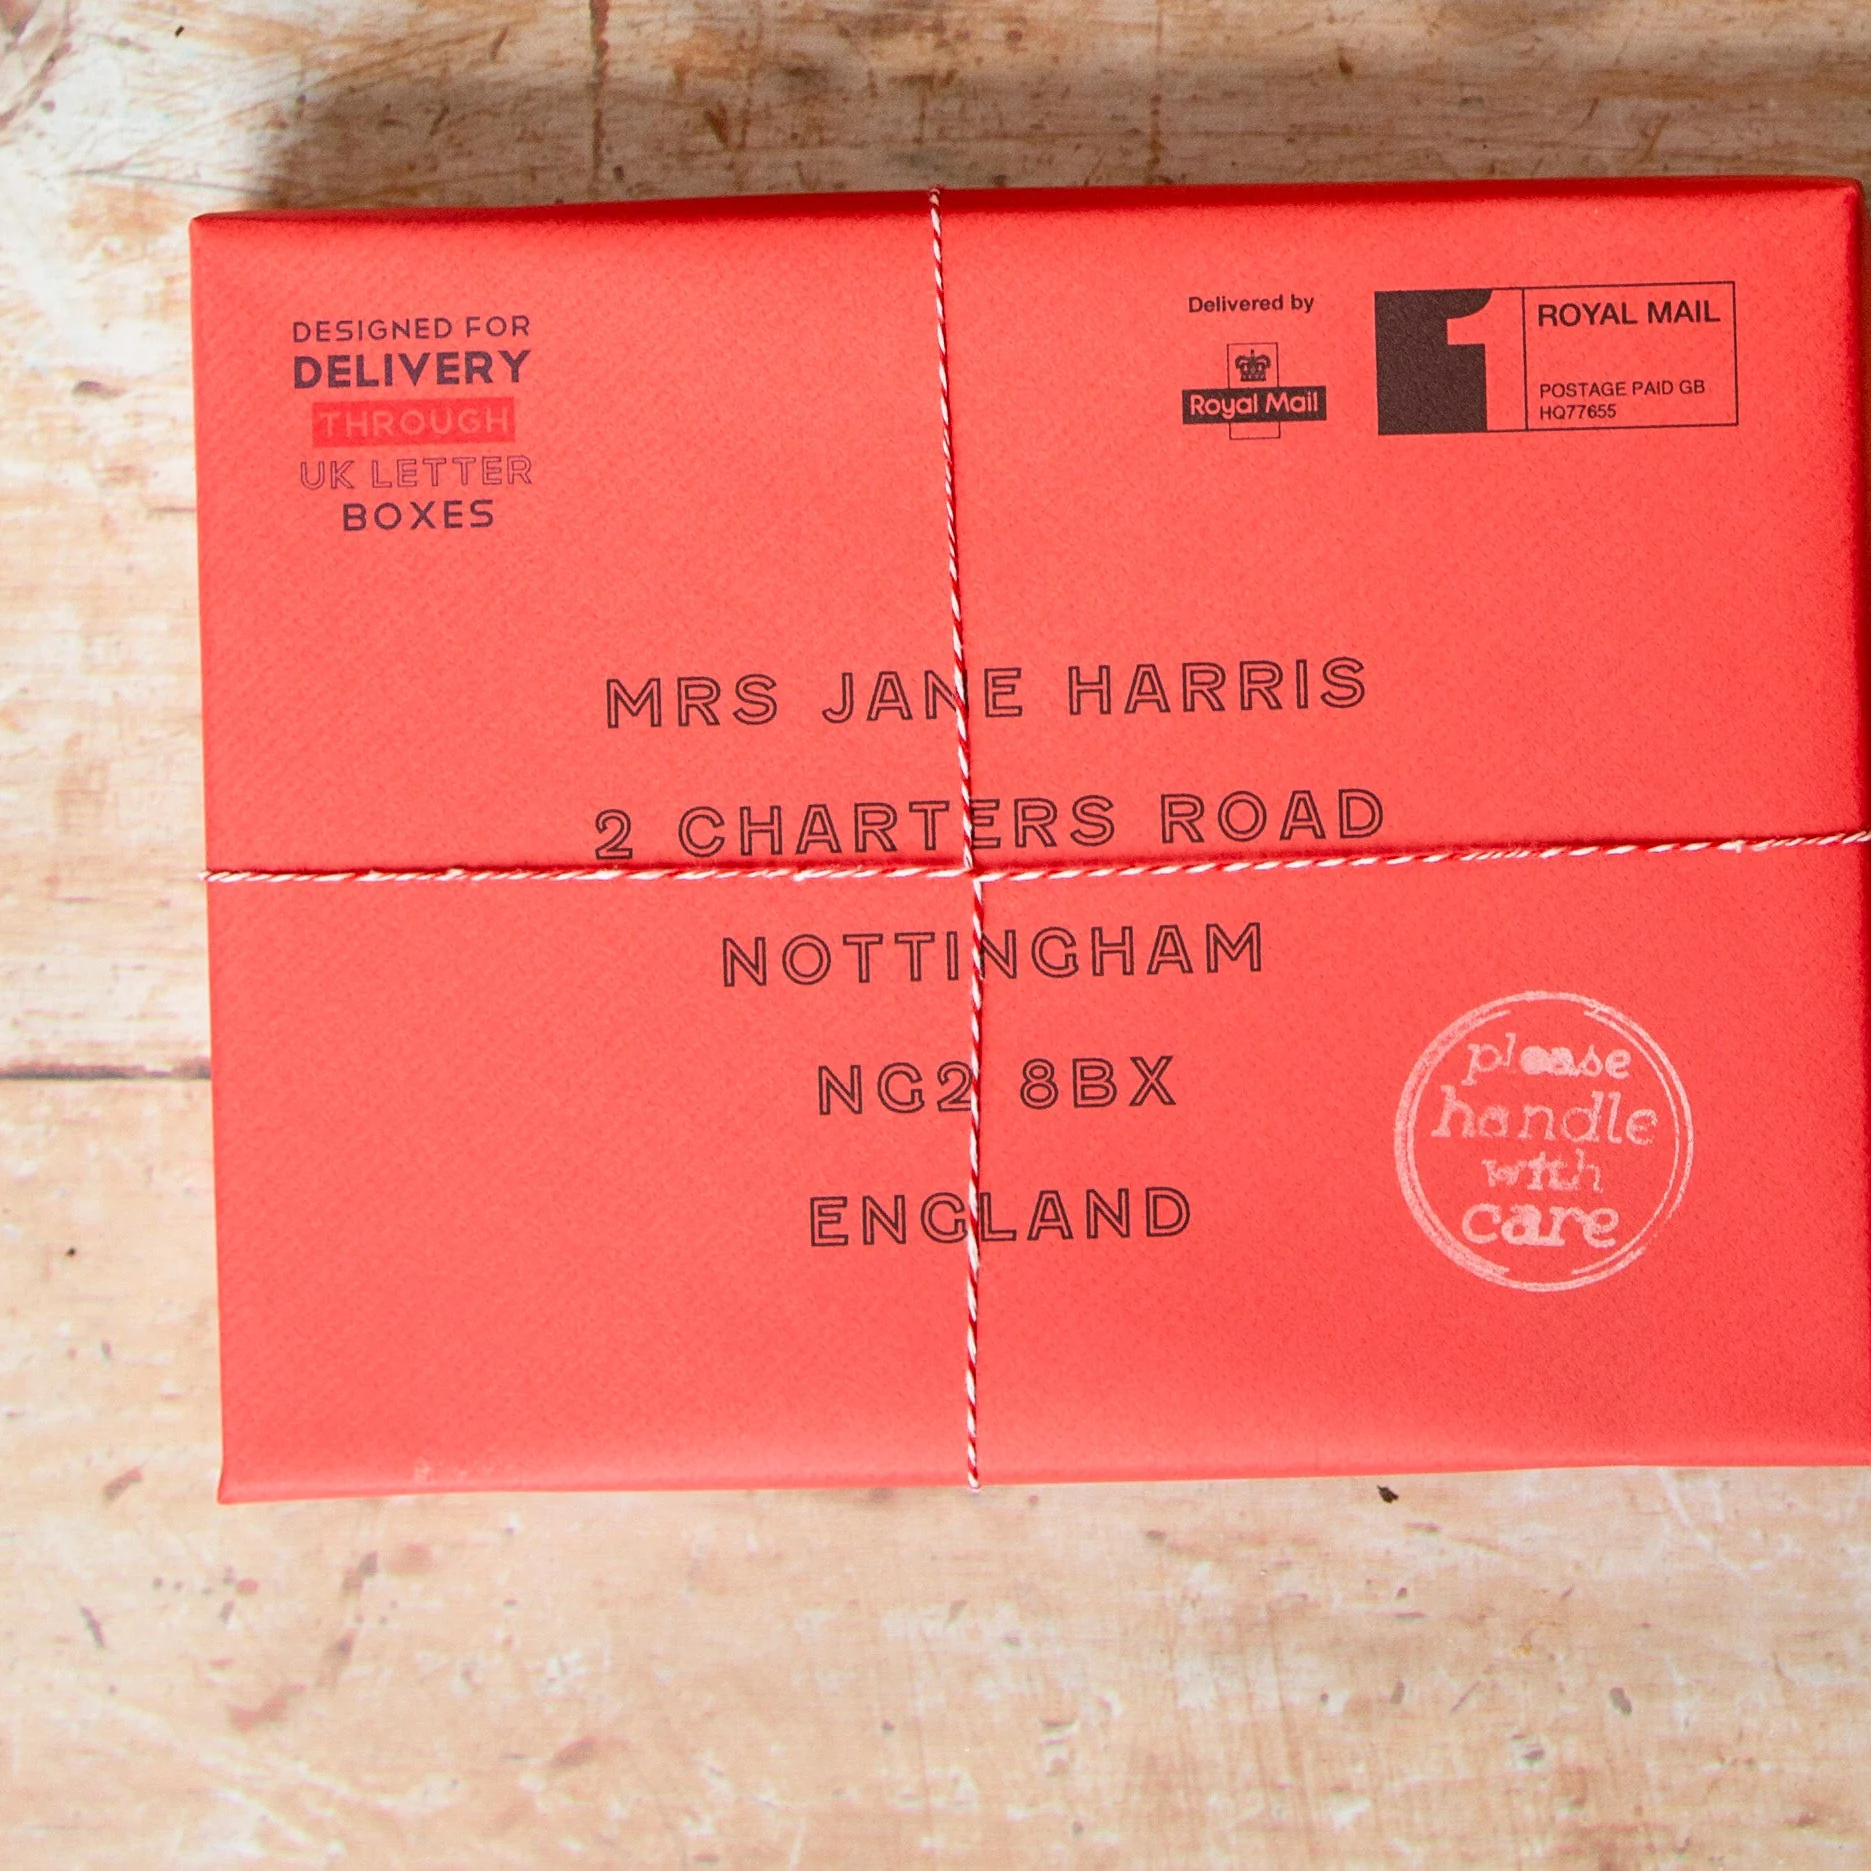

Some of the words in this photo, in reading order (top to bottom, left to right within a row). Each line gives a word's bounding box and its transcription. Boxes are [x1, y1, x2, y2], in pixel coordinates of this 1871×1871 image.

[1188, 293, 1285, 315] Delivered
[1291, 293, 1315, 316] by
[1537, 301, 1637, 327] ROYAL
[1647, 299, 1720, 324] MAIL
[292, 317, 453, 344] DESIGNED
[466, 314, 530, 338] FOR
[293, 349, 531, 389] DELIVERY
[1539, 381, 1627, 399] POSTAGE
[1632, 380, 1674, 397] PAID
[1678, 378, 1706, 396] GB
[319, 408, 510, 438] THROUGH
[1189, 391, 1259, 420] Royal
[1265, 390, 1318, 416] Mail
[1539, 402, 1617, 421] HQ77655
[300, 460, 355, 490] UK
[371, 455, 533, 489] LETTER
[343, 499, 495, 532] BOXES
[606, 673, 779, 729] MRS
[822, 666, 1023, 724] JANE
[1068, 656, 1367, 716] HARRIS
[595, 808, 633, 860] 2
[677, 792, 1116, 858] CHARTERS
[1160, 787, 1385, 846] ROAD
[722, 922, 1263, 987] NOTTINGHAM
[1461, 1032, 1632, 1086] please
[818, 1061, 974, 1115] NG2
[1019, 1055, 1177, 1110] 8BX
[1431, 1084, 1658, 1145] handle
[1481, 1148, 1604, 1193] with
[810, 1186, 1191, 1247] ENGLAND
[1462, 1202, 1619, 1248] care
